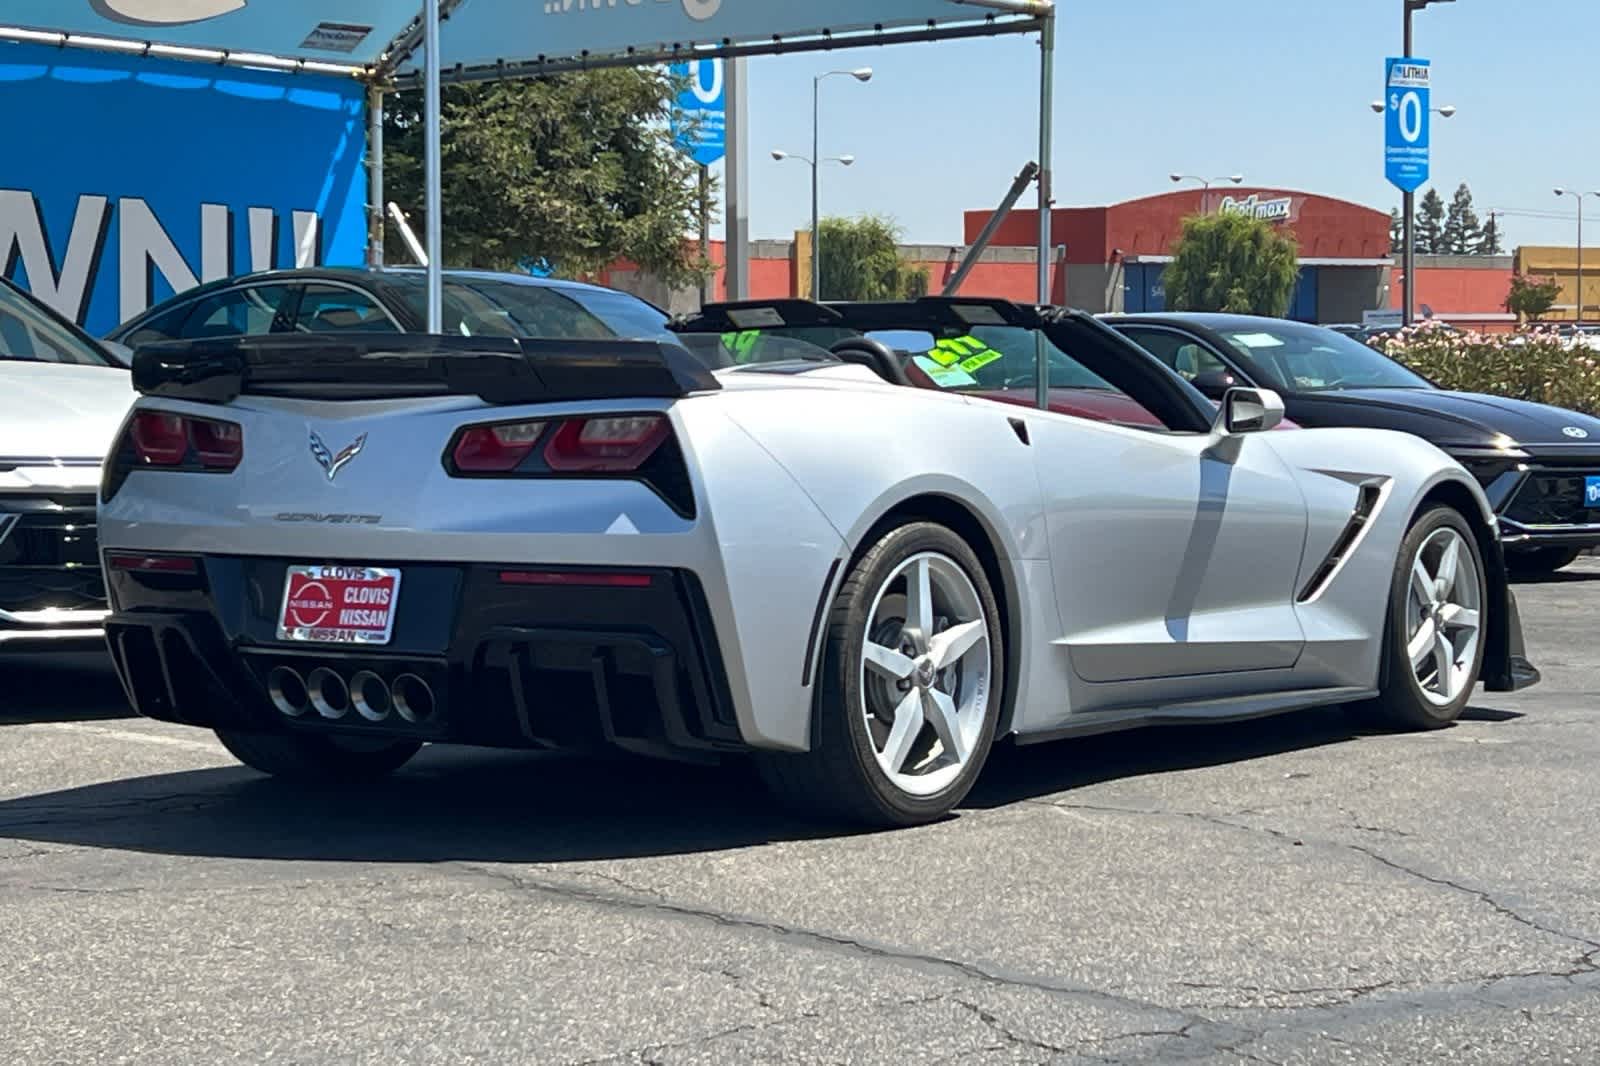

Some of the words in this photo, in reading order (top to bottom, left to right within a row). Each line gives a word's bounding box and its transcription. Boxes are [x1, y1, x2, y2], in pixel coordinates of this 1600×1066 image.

[1402, 66, 1429, 80] LITHIA
[272, 512, 382, 524] CORVETTE
[320, 566, 366, 580] CLOVIS
[343, 586, 390, 605] CLOVIS
[288, 600, 333, 609] NISSAN
[339, 609, 388, 626] NISSAN
[309, 629, 356, 641] NISSAN
